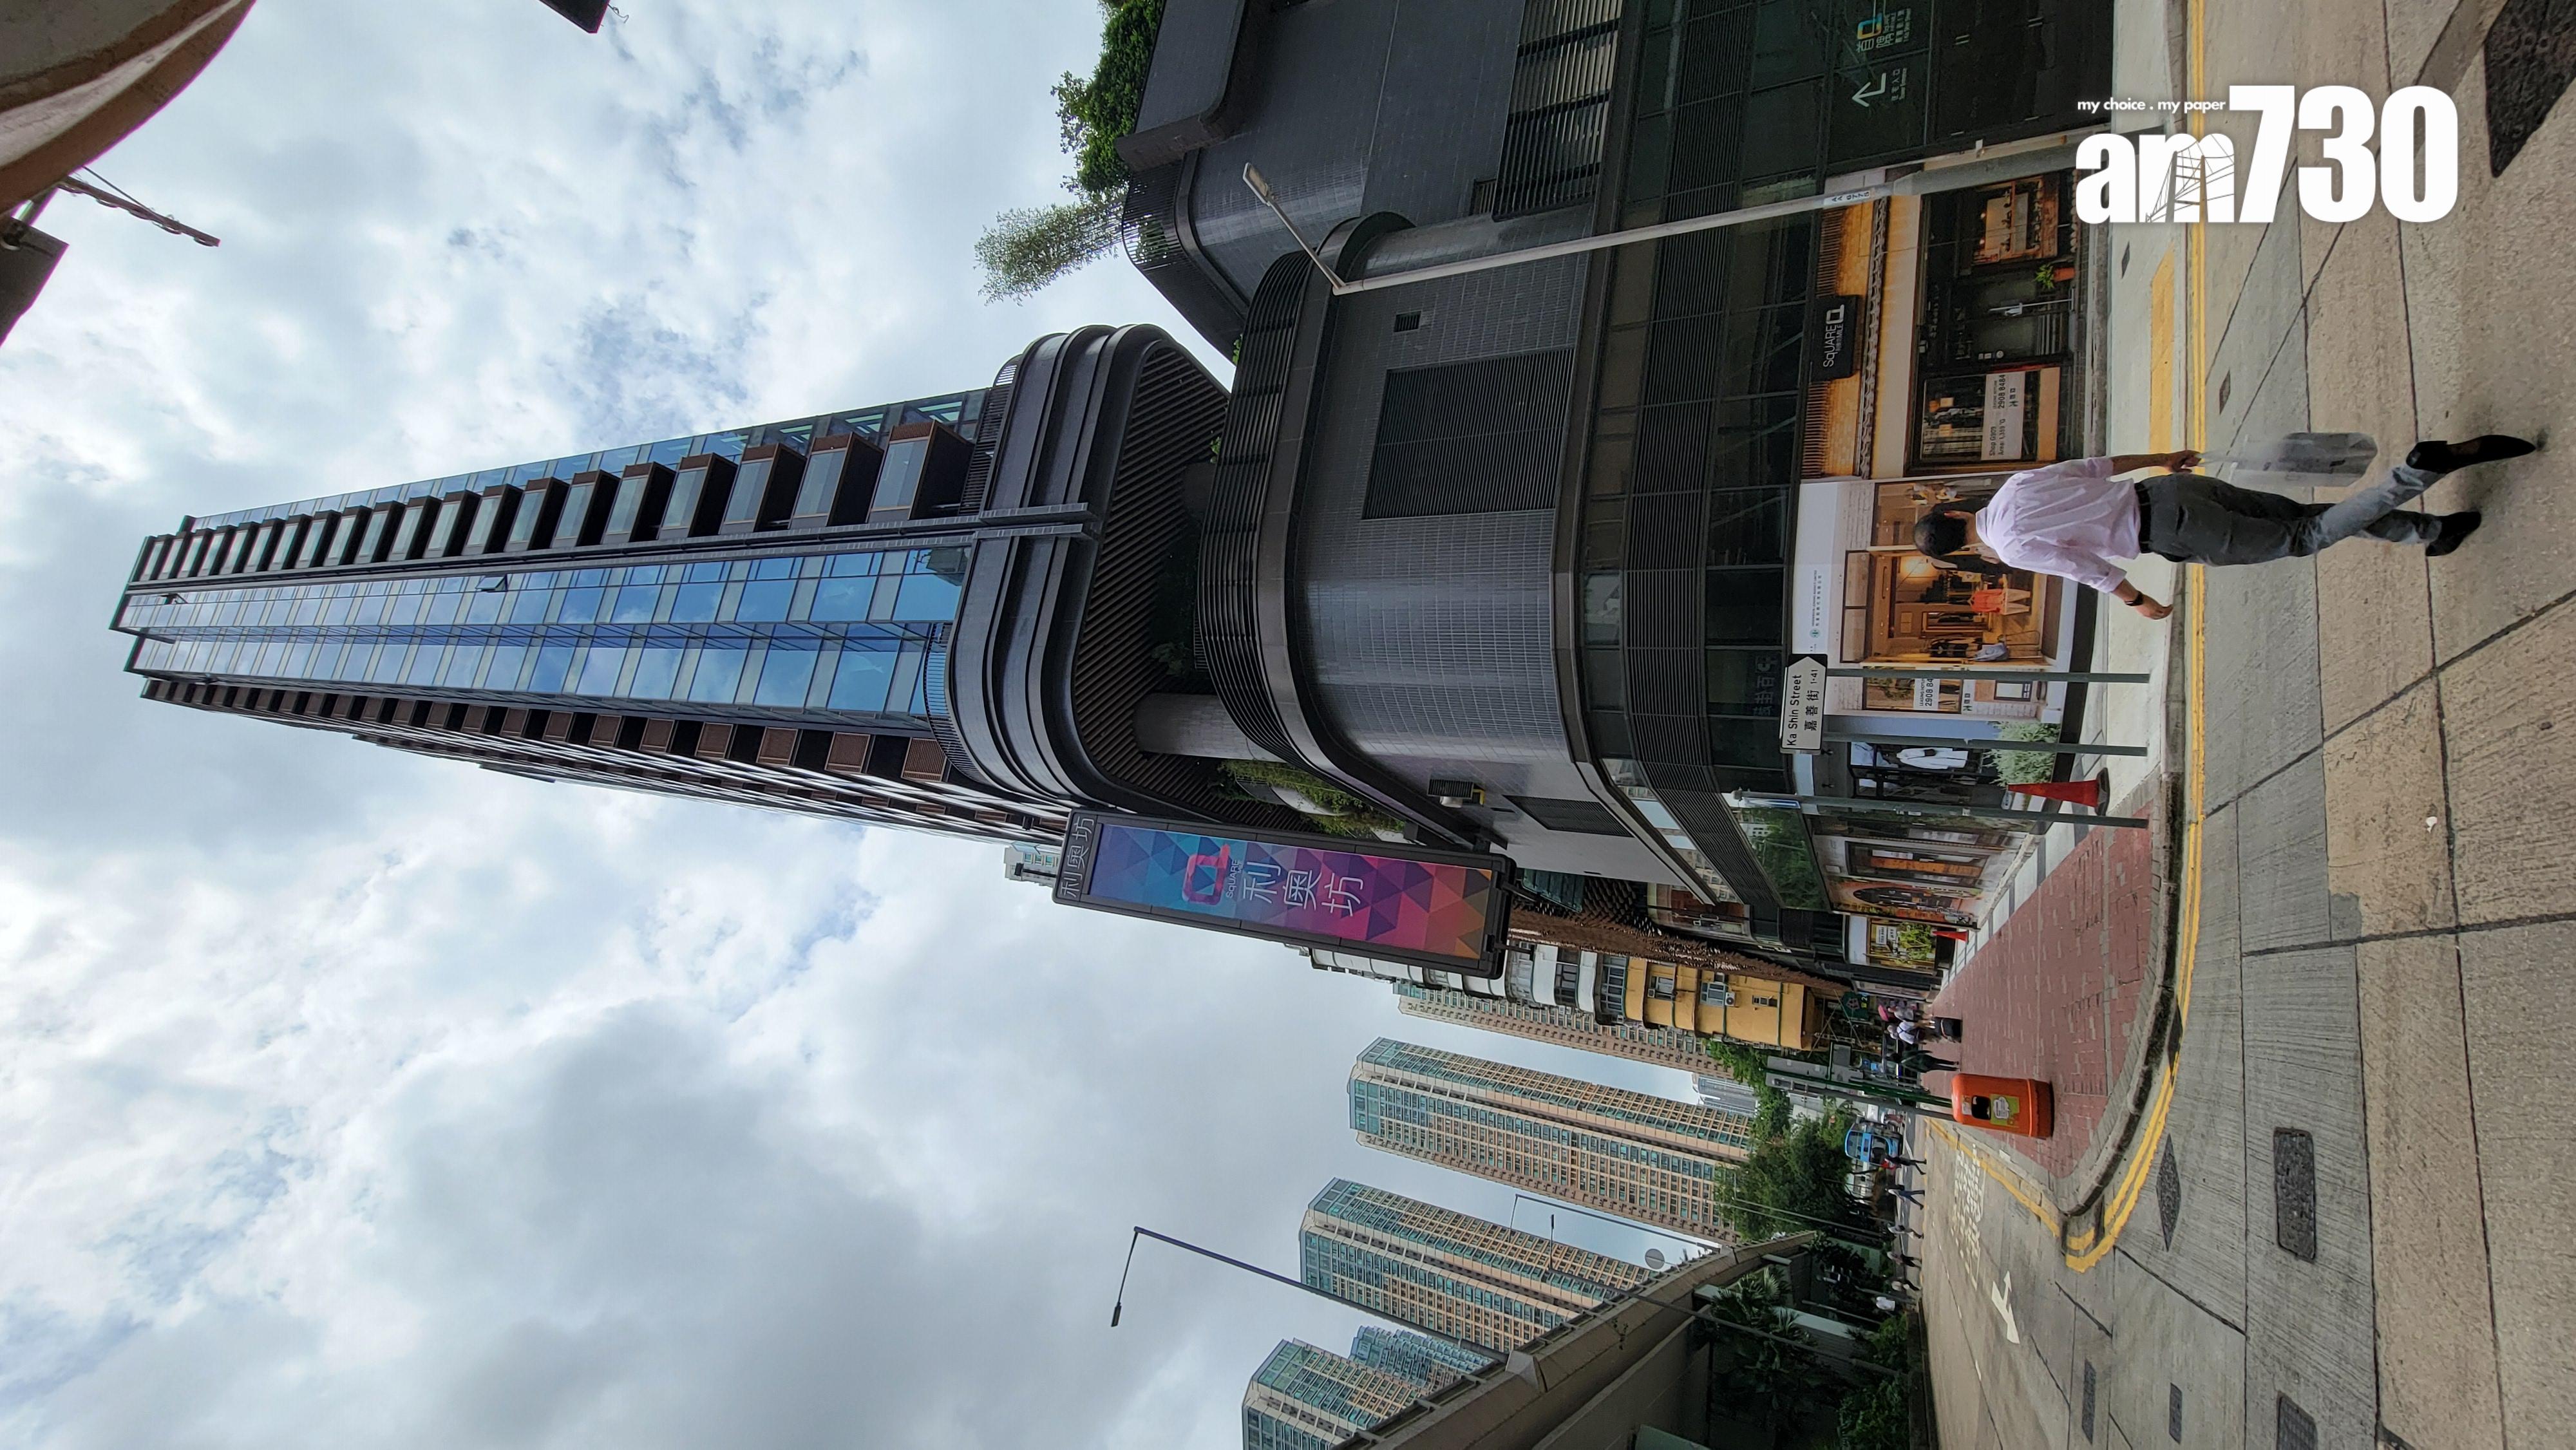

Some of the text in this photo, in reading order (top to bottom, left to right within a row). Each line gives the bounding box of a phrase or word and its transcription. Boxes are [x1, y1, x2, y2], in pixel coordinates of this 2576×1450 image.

[1989, 442, 1997, 457] Shop
[1786, 675, 1802, 746] Ka Shin Street
[1804, 690, 1819, 731] 嘉善街
[1925, 689, 1933, 706] 2908
[1060, 816, 1094, 898] 利奧坊
[1242, 862, 1363, 916] 利奧坊
